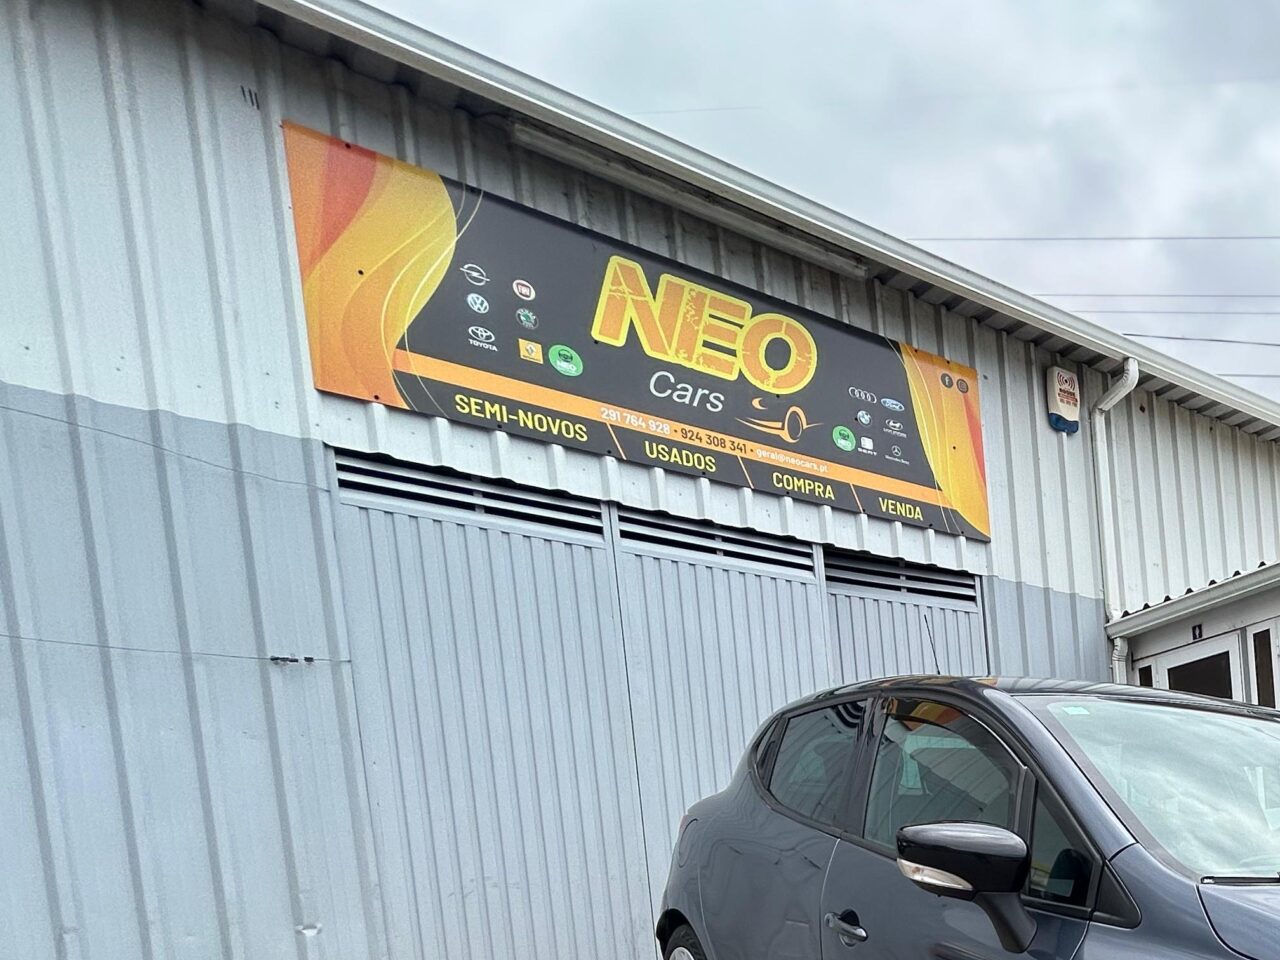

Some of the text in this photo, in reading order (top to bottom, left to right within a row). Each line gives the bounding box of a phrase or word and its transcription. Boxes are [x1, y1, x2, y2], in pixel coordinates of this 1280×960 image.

[590, 255, 818, 395] NEO
[468, 338, 498, 352] TOYOTA
[649, 370, 725, 413] Cars
[454, 394, 589, 442] SEMI-NOVOS
[600, 407, 829, 474] 291 764 928 924 308 341 geral@neocars.pt
[644, 440, 717, 473] USADOS
[772, 471, 836, 501] COMPRA
[879, 496, 924, 522] VENDA
